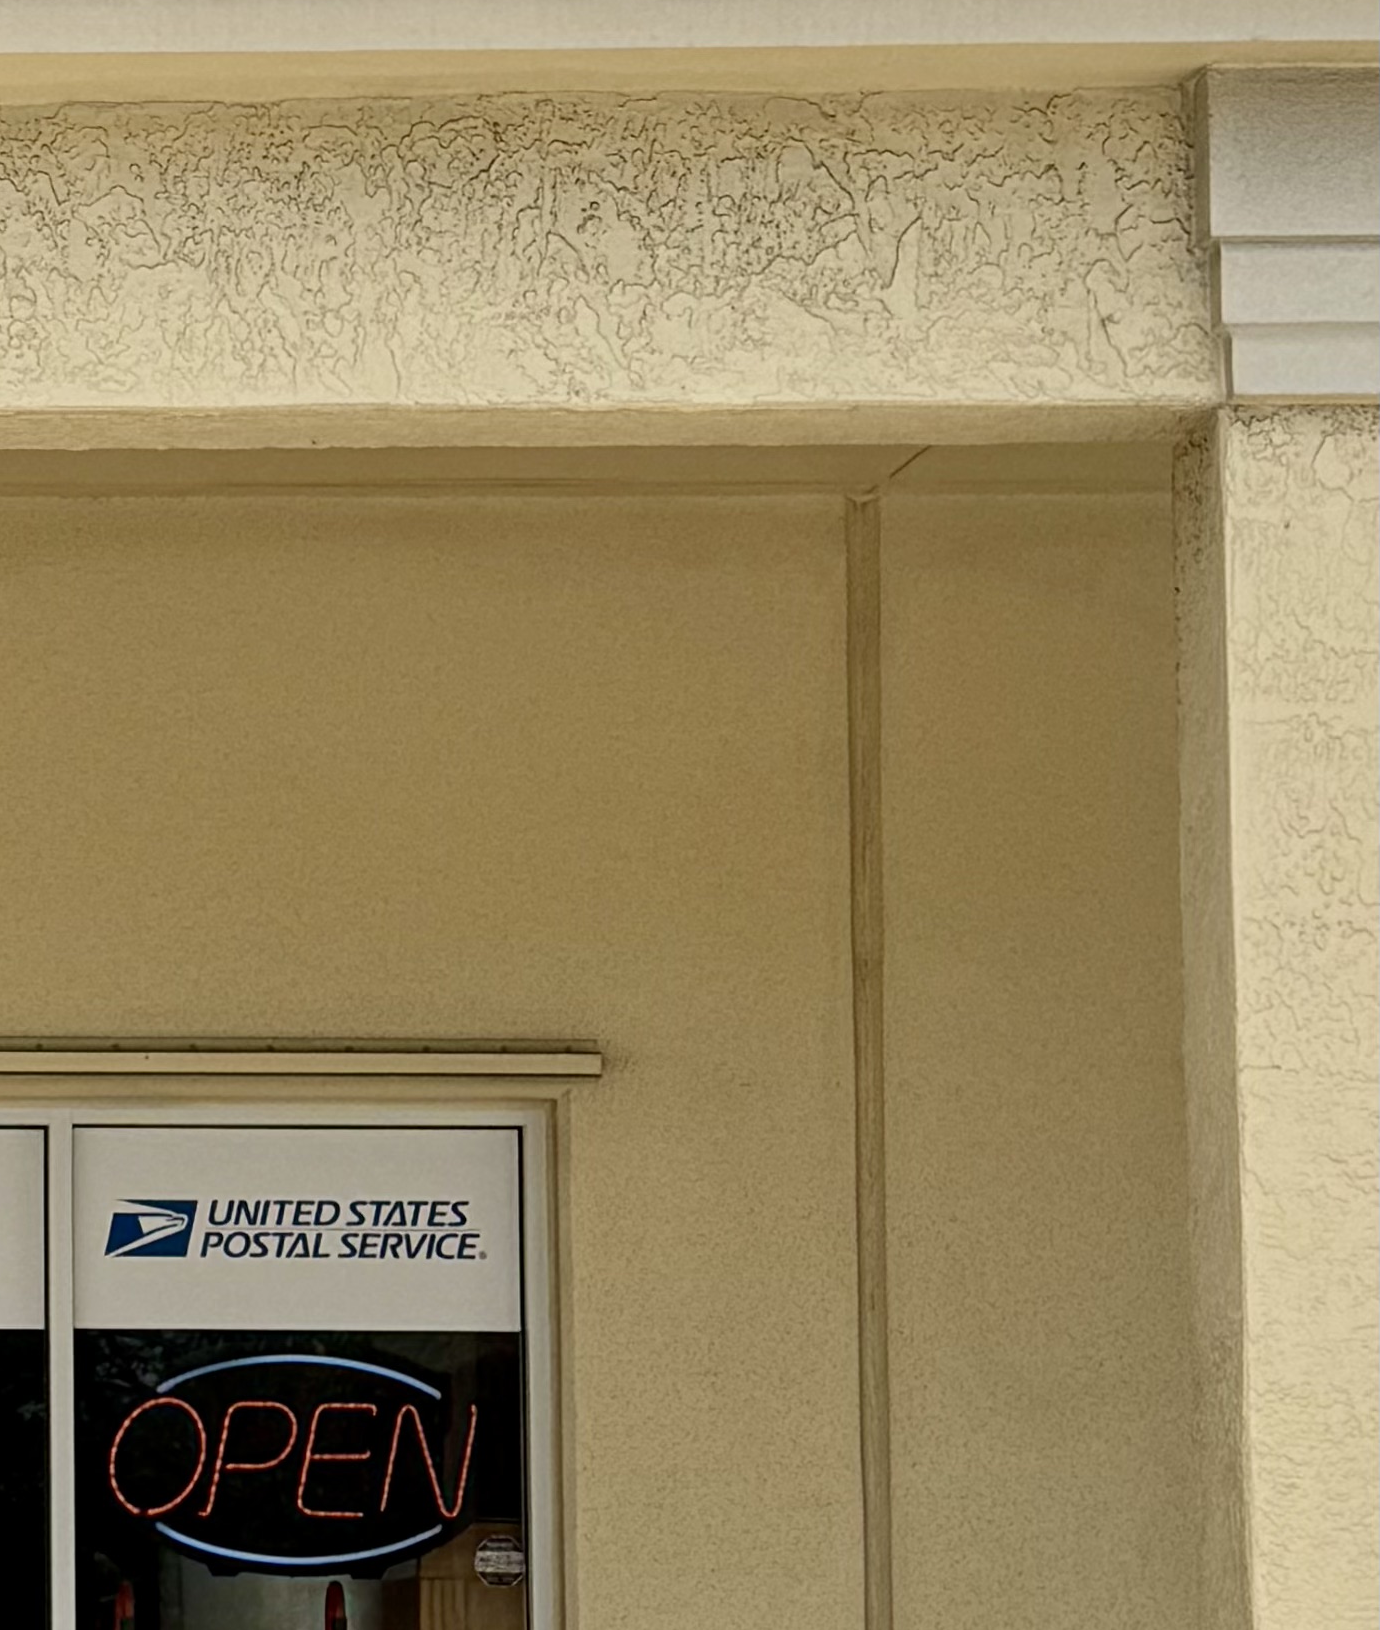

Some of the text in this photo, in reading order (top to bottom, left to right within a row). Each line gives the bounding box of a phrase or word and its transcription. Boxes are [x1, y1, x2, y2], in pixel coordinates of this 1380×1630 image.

[207, 1199, 470, 1227] UNITED STATES
[199, 1232, 331, 1259] POSTAL
[109, 1397, 478, 1518] OPEN
